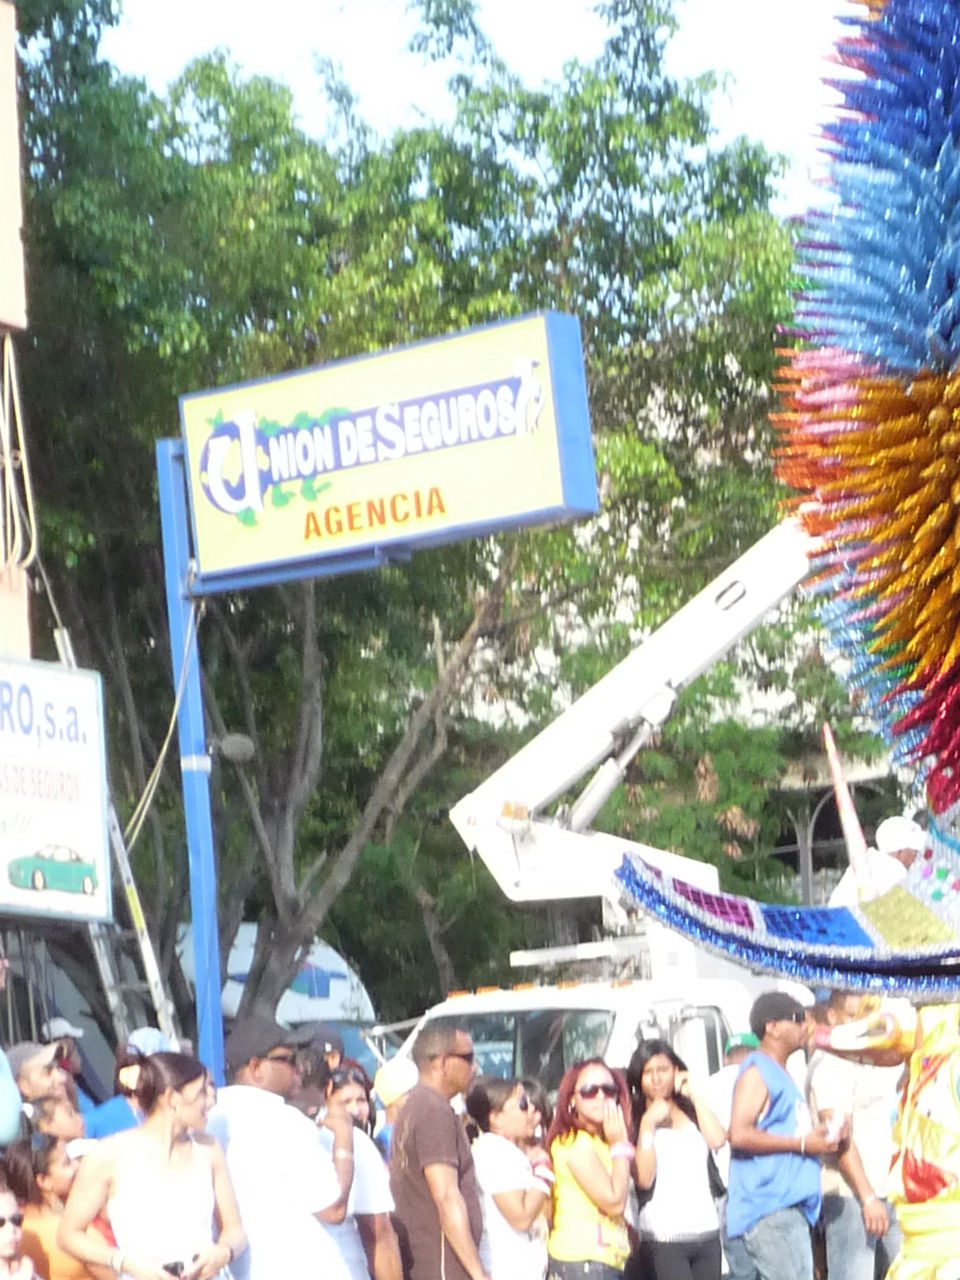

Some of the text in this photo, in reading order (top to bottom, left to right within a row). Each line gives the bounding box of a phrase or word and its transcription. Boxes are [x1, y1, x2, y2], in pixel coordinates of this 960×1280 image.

[206, 385, 518, 516] UNION DE SEGUROS
[303, 486, 447, 540] AGENCIA
[13, 765, 27, 796] DE
[30, 767, 81, 803] SEGUROS
